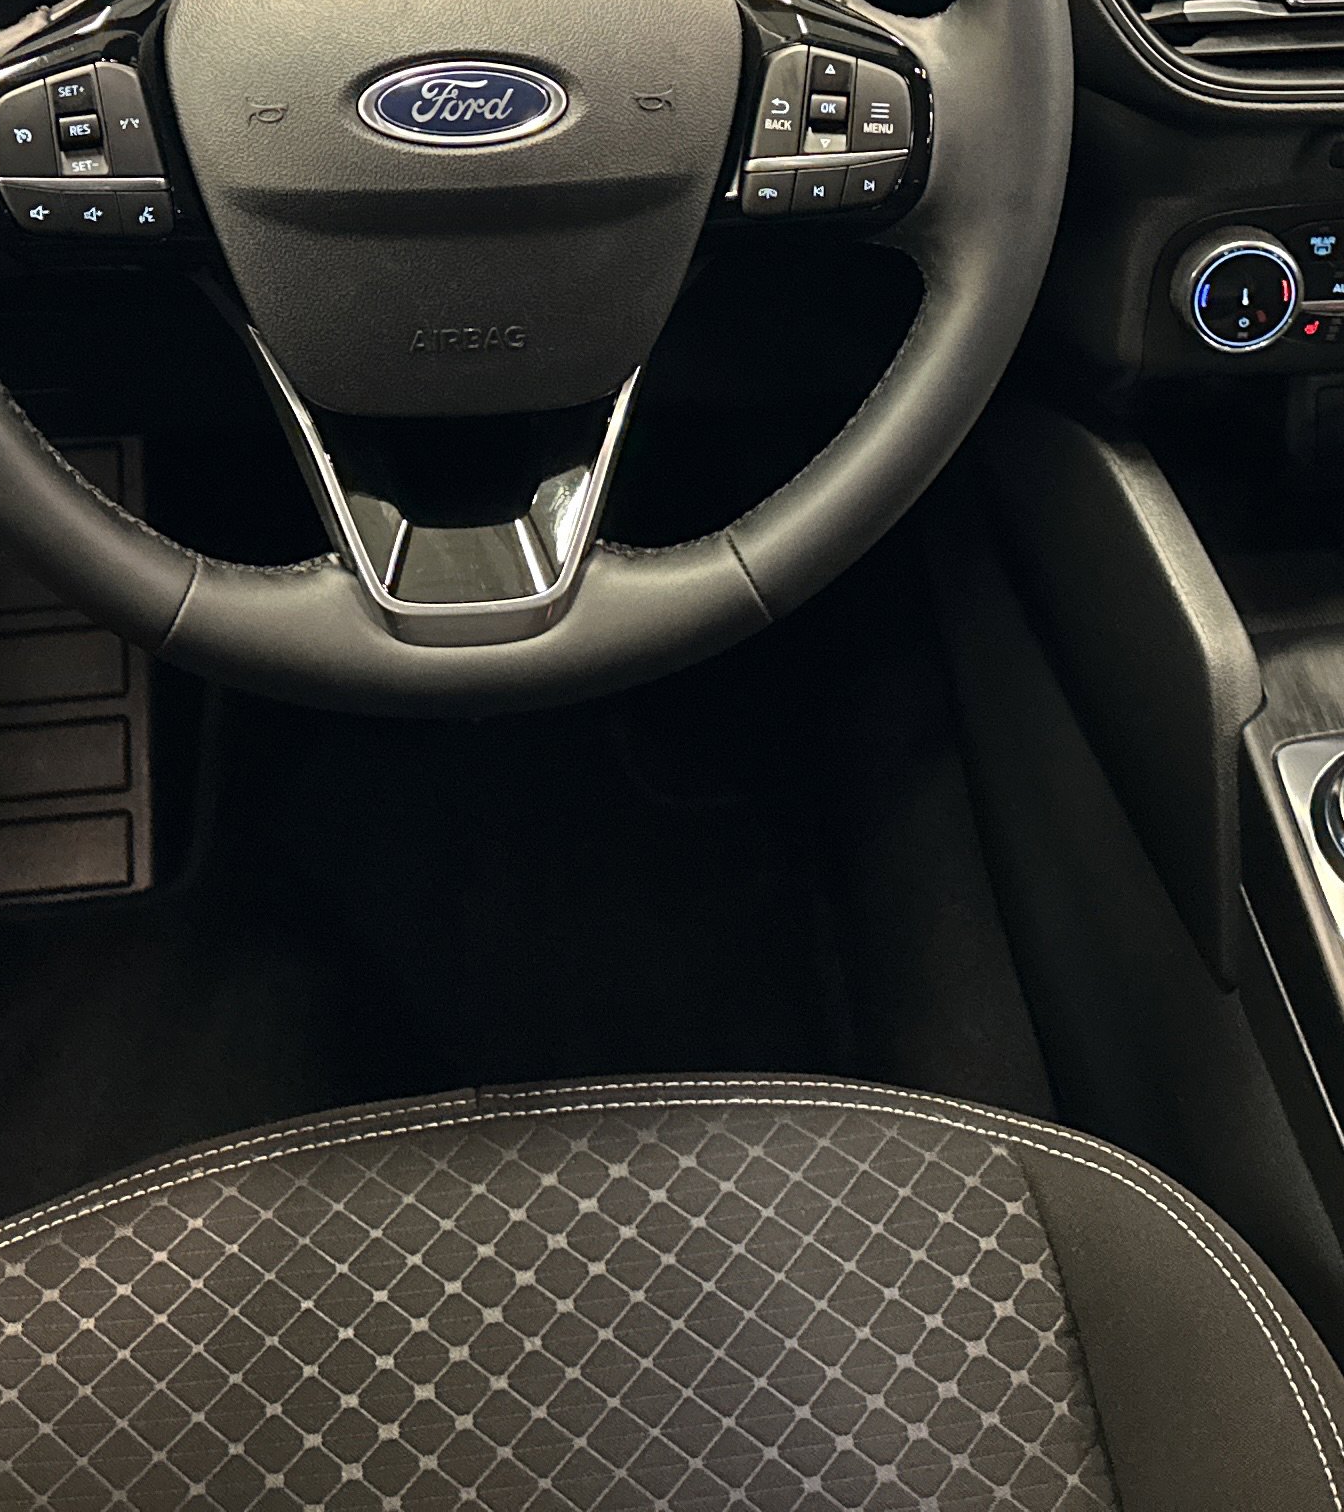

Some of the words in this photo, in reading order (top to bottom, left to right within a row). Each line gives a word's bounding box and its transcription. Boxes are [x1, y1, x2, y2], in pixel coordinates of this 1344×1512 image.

[58, 85, 85, 98] SET+
[411, 79, 514, 123] Ford
[820, 103, 836, 114] OK
[69, 124, 91, 136] RES
[764, 119, 792, 131] BACK
[863, 123, 894, 134] MENU
[409, 326, 526, 352] AIRBAG
